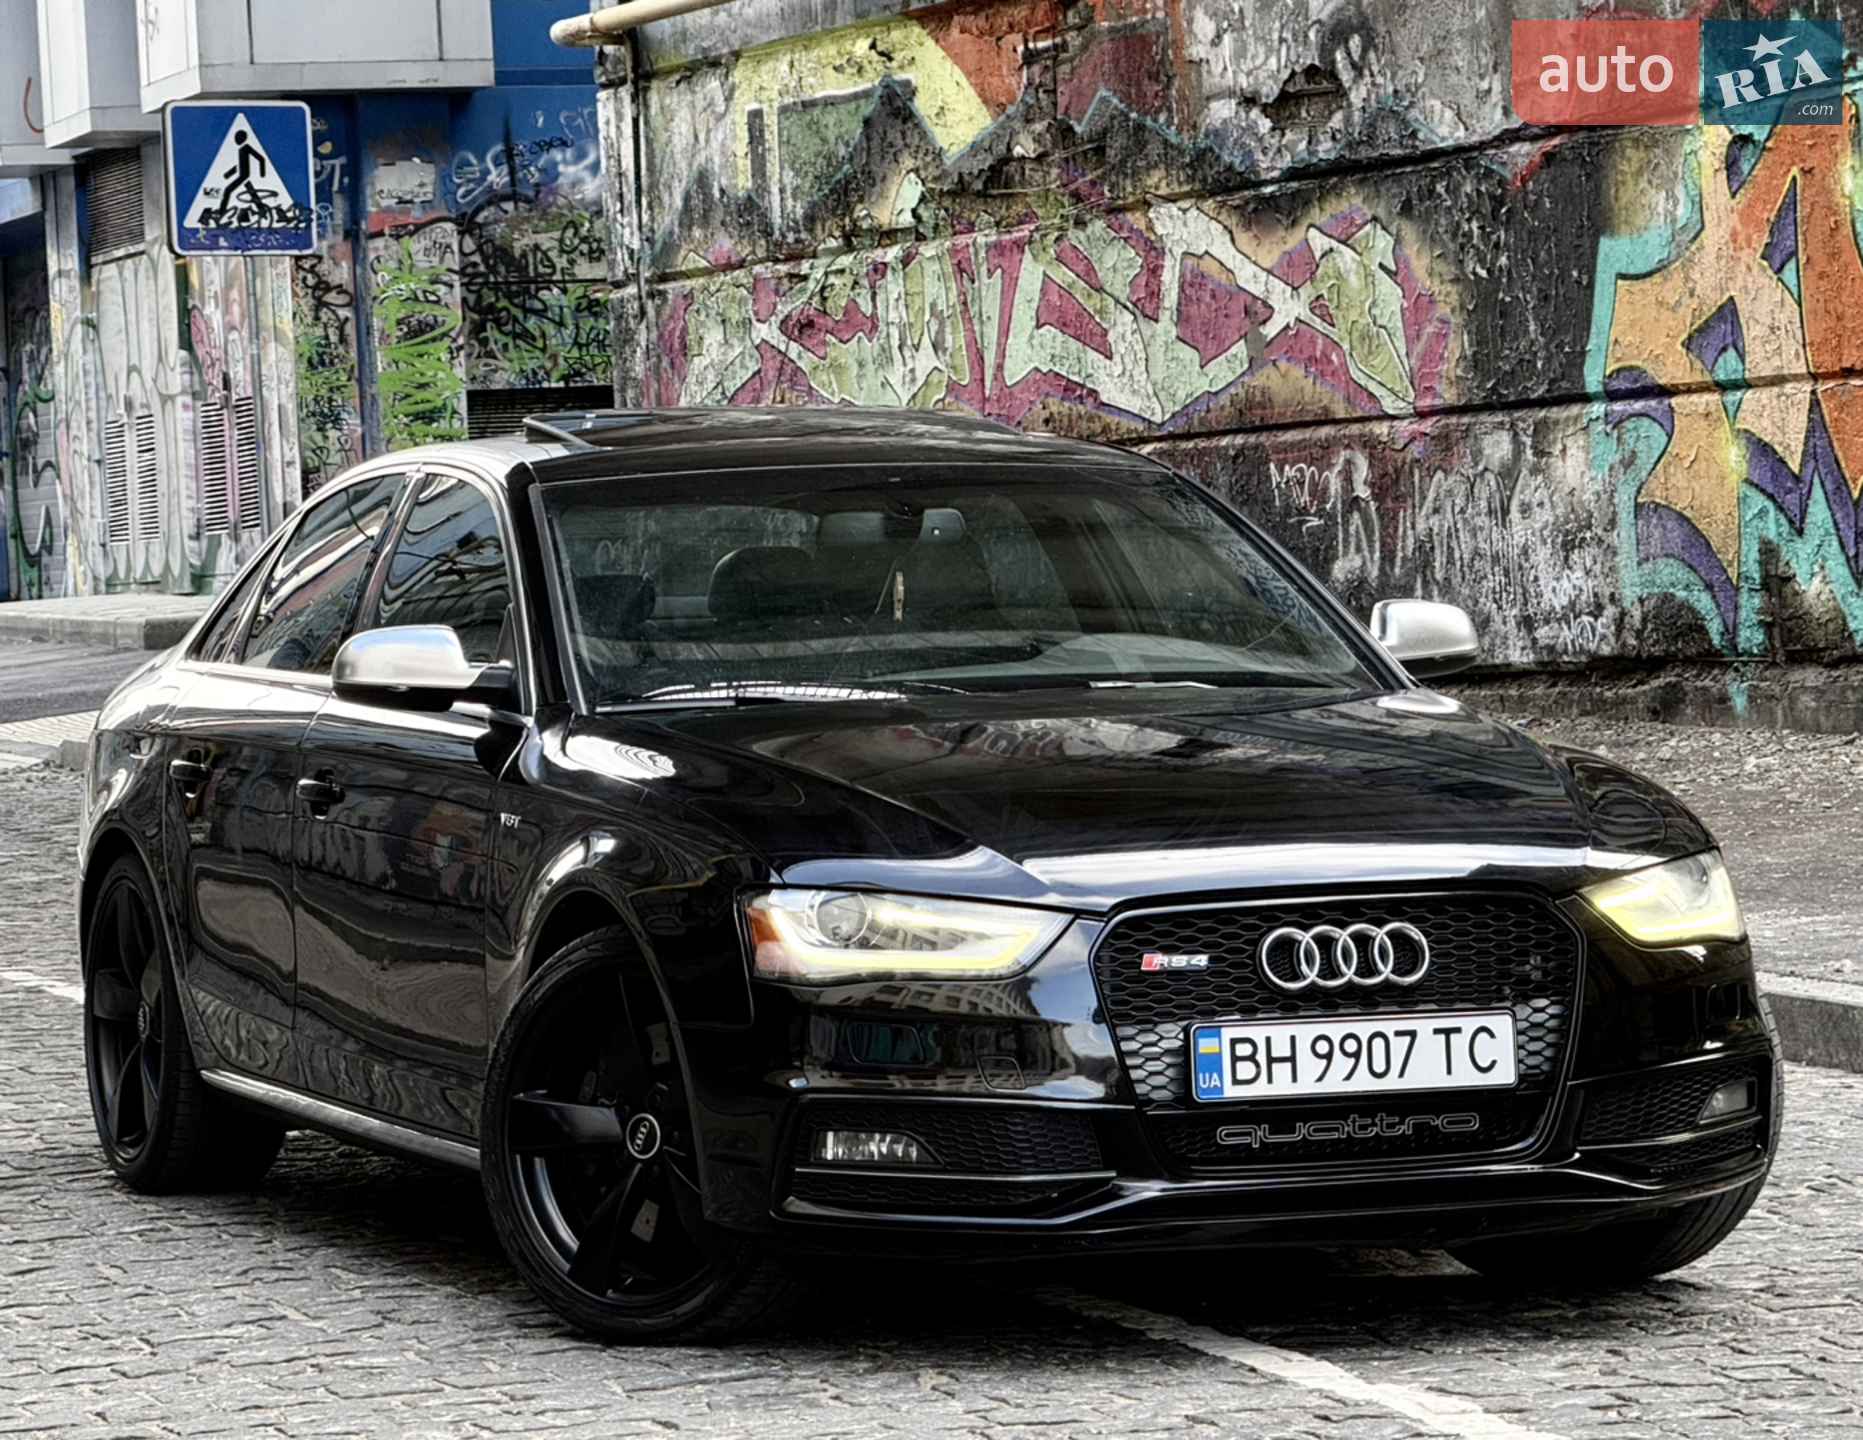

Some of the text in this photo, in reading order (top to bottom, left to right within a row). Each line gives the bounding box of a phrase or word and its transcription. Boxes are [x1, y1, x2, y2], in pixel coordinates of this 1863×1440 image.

[1150, 953, 1210, 970] RS4
[1229, 1024, 1498, 1087] BH 9907 TC
[1198, 1072, 1222, 1089] UA
[1216, 1112, 1480, 1149] quattro
